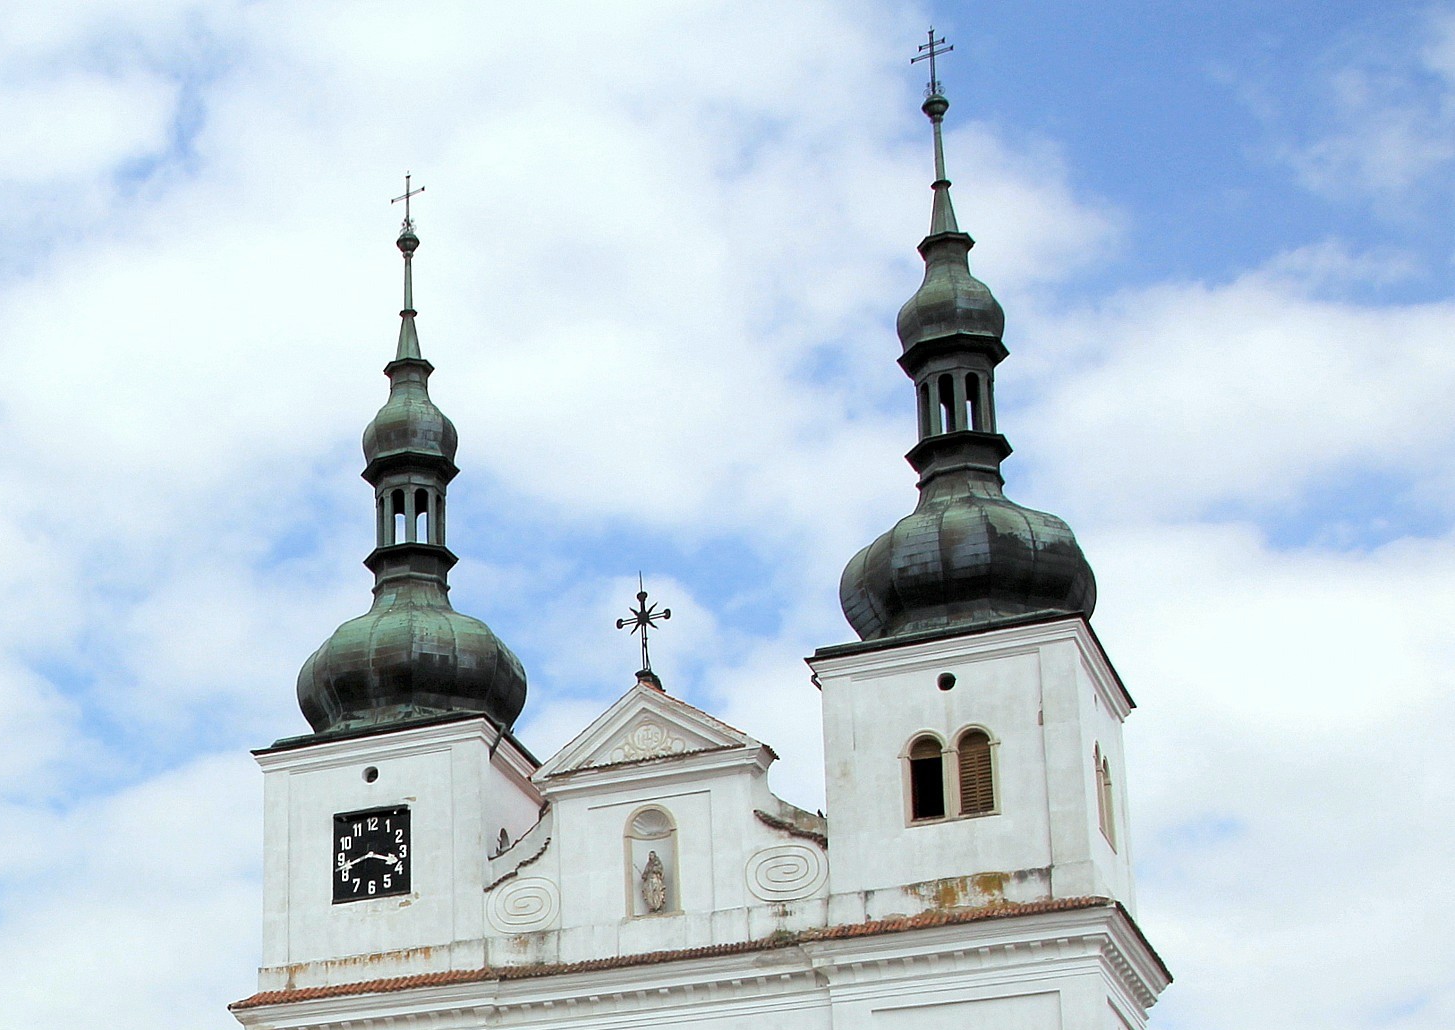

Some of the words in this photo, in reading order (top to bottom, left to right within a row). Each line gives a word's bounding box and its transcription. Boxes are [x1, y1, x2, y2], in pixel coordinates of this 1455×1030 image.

[352, 822, 362, 837] 11
[367, 817, 378, 831] 12
[385, 819, 391, 833] 1
[395, 829, 403, 843] 2
[340, 836, 352, 851] 10
[399, 844, 407, 858] 3
[338, 852, 345, 866] 9
[394, 861, 403, 875] 4
[352, 878, 360, 892] 7
[368, 880, 376, 894] 6
[384, 874, 392, 888] 5
